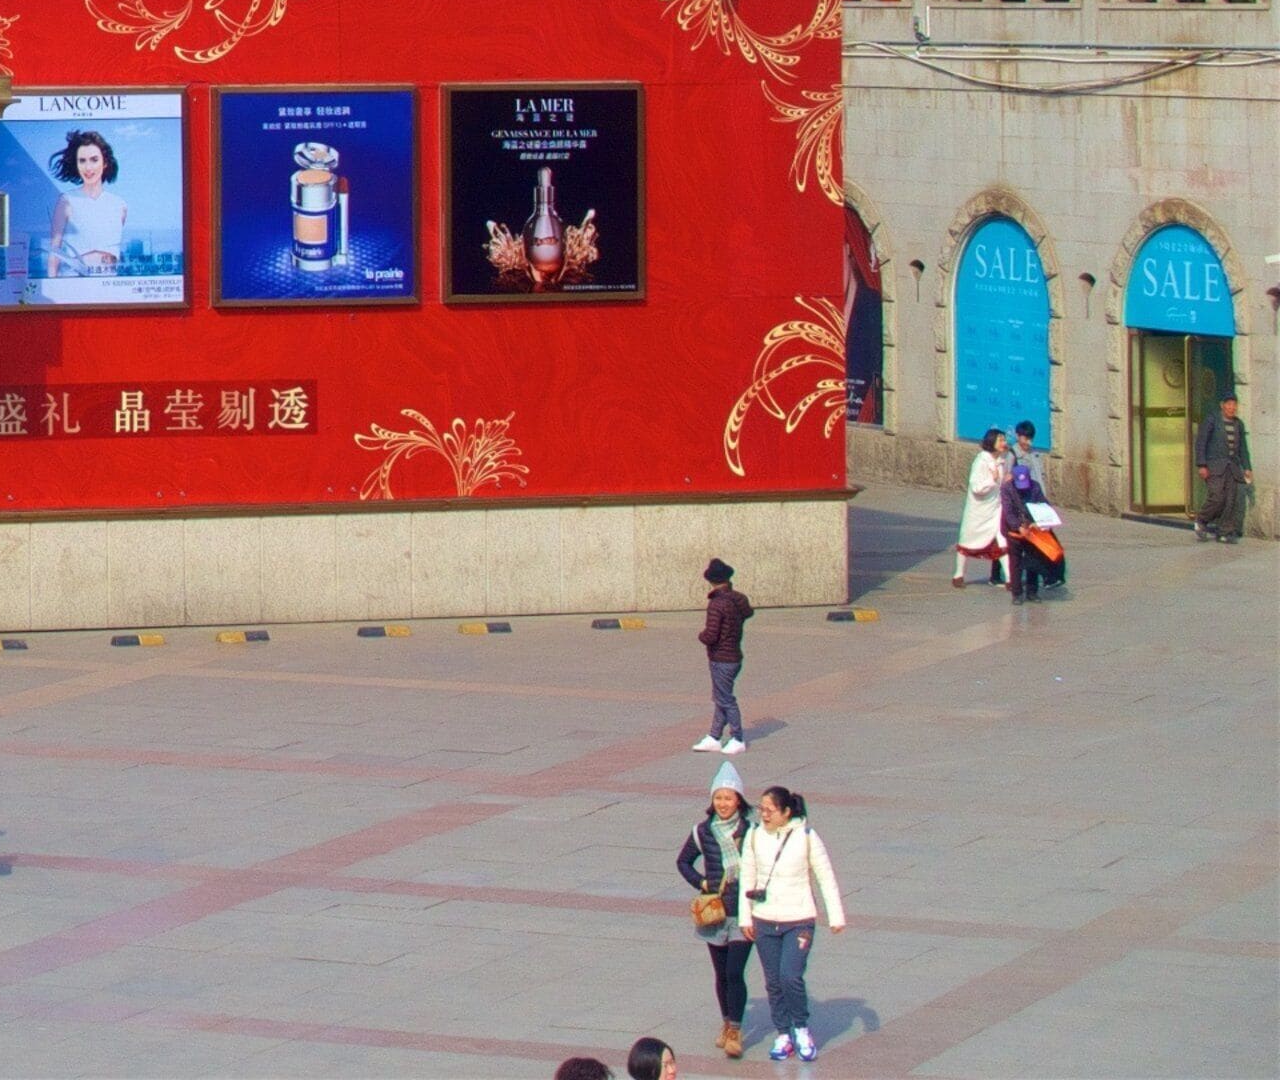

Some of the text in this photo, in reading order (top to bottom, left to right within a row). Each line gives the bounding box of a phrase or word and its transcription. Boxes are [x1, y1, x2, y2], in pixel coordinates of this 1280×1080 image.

[516, 98, 574, 112] LA MER
[975, 244, 1040, 283] SALE
[1143, 258, 1220, 302] SALE
[114, 386, 310, 433] 晶莹剔透
